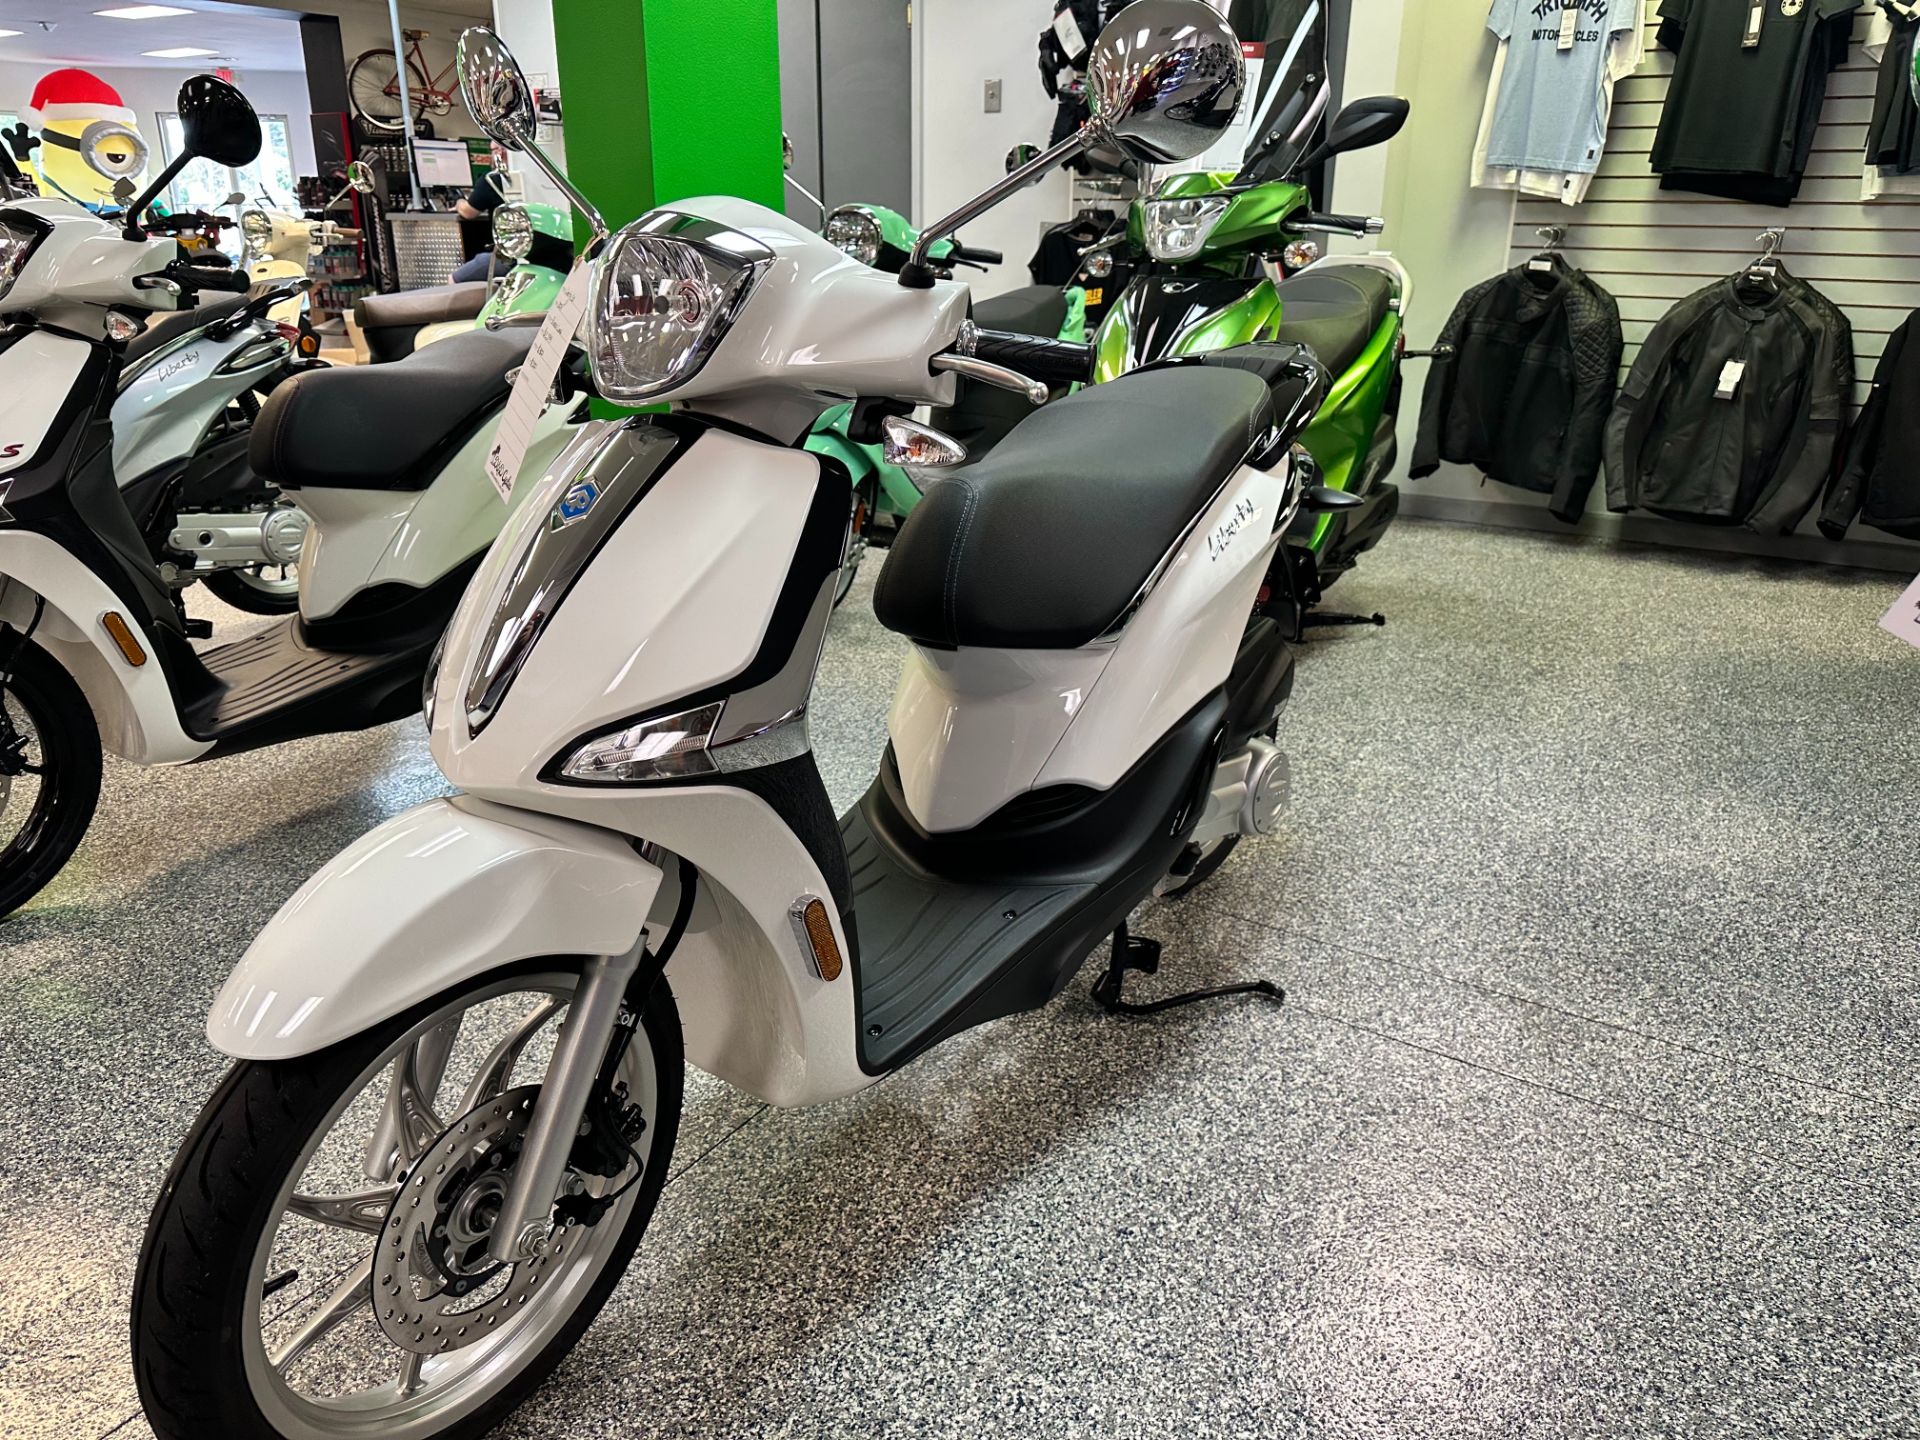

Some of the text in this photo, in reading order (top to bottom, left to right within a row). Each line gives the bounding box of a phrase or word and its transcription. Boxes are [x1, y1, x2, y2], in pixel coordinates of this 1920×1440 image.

[1531, 0, 1608, 24] TRIUMPH
[158, 351, 199, 382] Liberty
[0, 443, 24, 459] S
[1207, 498, 1255, 562] Liberty
